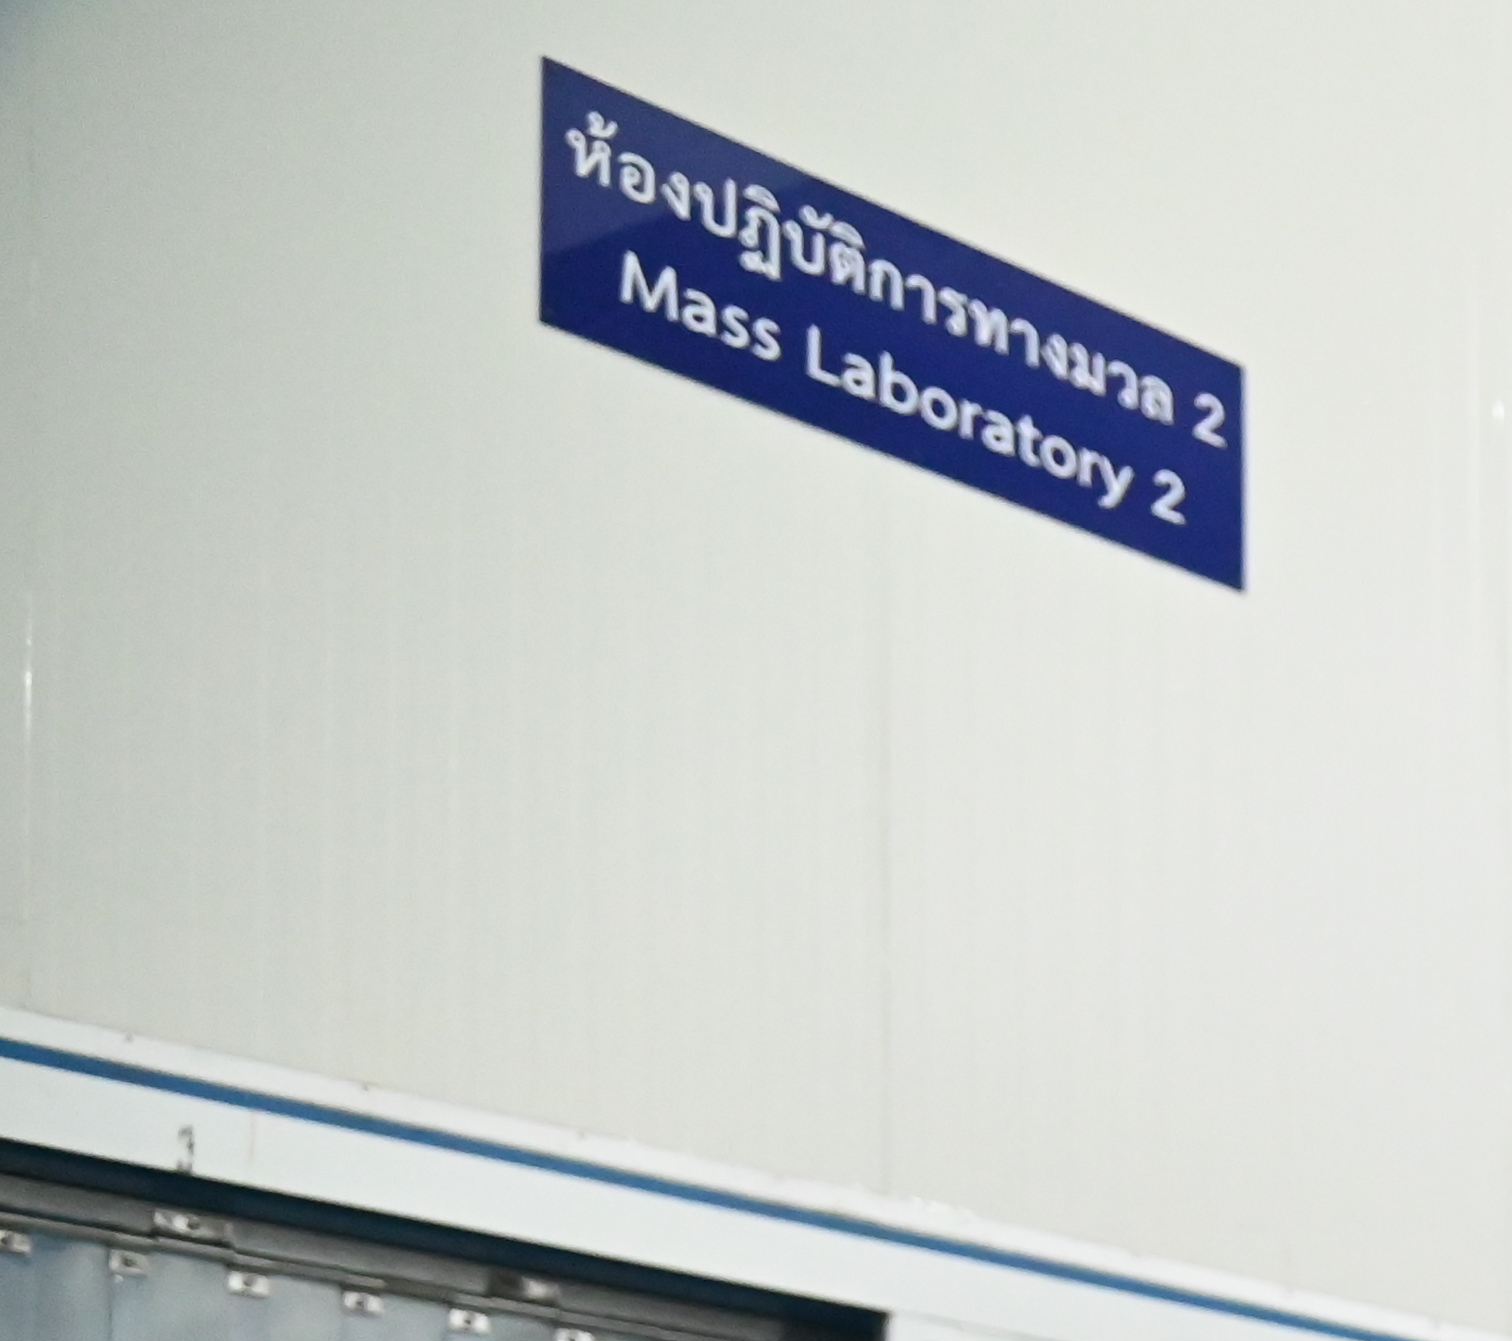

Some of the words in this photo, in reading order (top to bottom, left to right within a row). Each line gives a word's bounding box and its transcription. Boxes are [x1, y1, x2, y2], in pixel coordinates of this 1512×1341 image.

[565, 111, 1175, 425] ห้องปฏิบัติการทางมวล
[1192, 392, 1228, 448] 2
[619, 250, 782, 363] Mass
[804, 325, 1135, 510] Laboratory
[1151, 469, 1187, 525] 2
